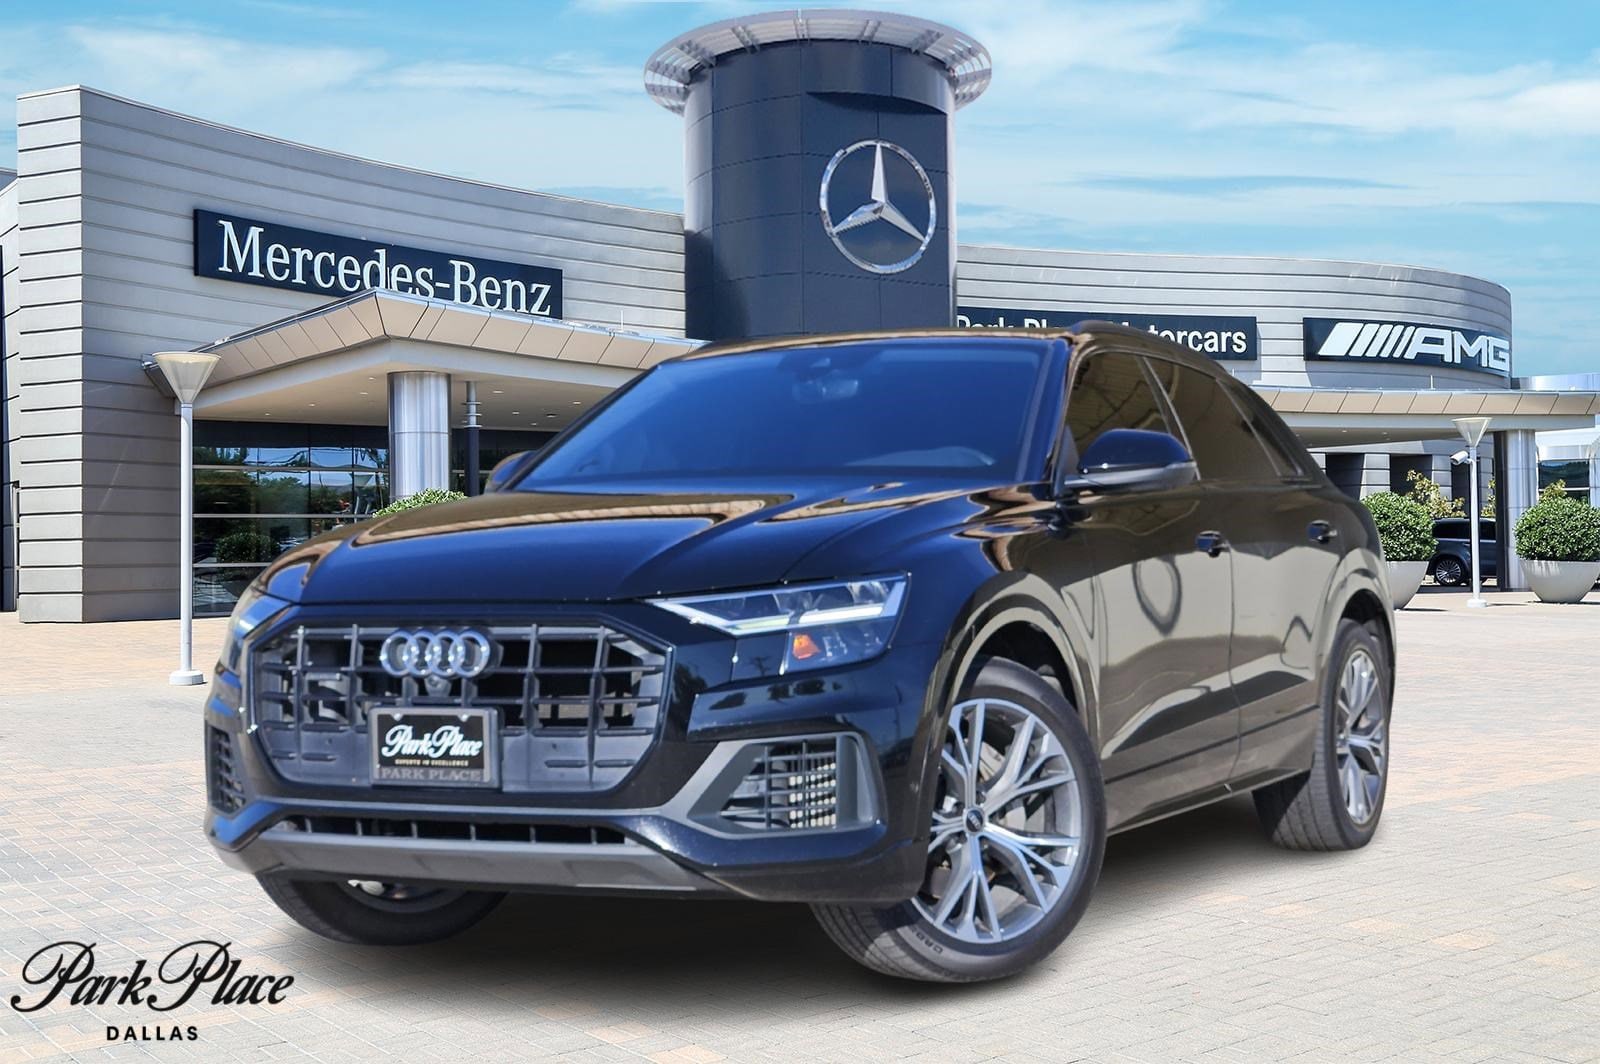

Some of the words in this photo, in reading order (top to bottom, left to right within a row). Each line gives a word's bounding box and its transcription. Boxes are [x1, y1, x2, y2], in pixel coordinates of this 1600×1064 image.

[218, 219, 552, 316] Mercedes-Benz
[381, 724, 432, 758] Park
[428, 725, 483, 758] Place
[381, 767, 425, 780] PARK
[429, 768, 482, 781] PLACE
